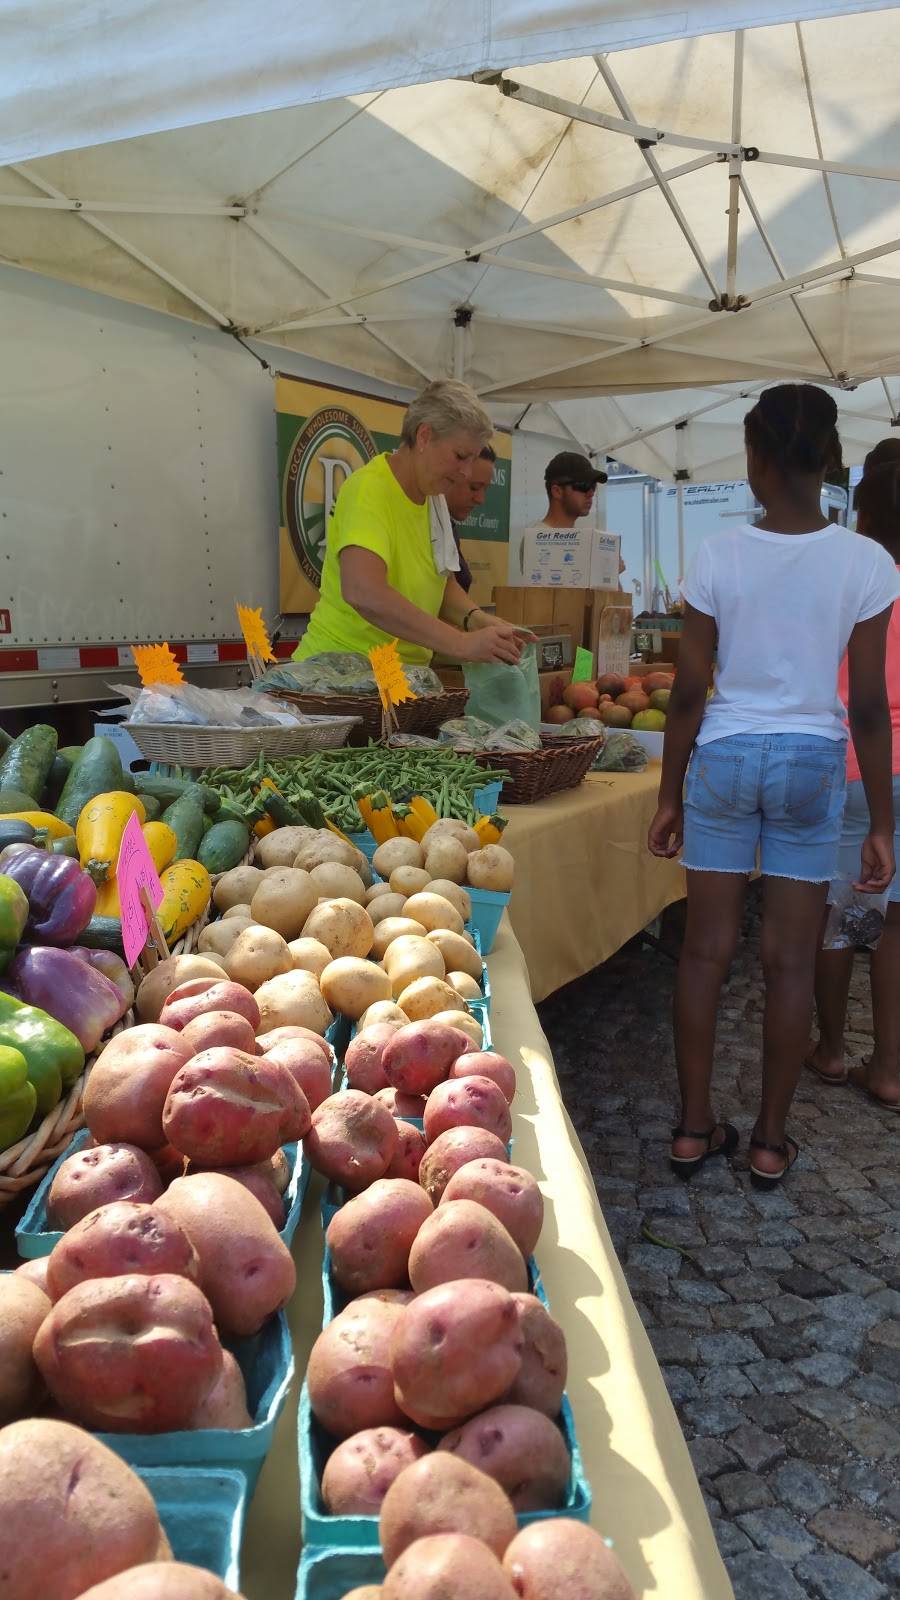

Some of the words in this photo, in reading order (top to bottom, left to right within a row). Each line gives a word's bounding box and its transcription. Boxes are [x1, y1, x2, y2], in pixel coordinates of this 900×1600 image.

[536, 532, 551, 540] Get
[553, 531, 578, 540] Reddi
[301, 558, 320, 586] TASTE
